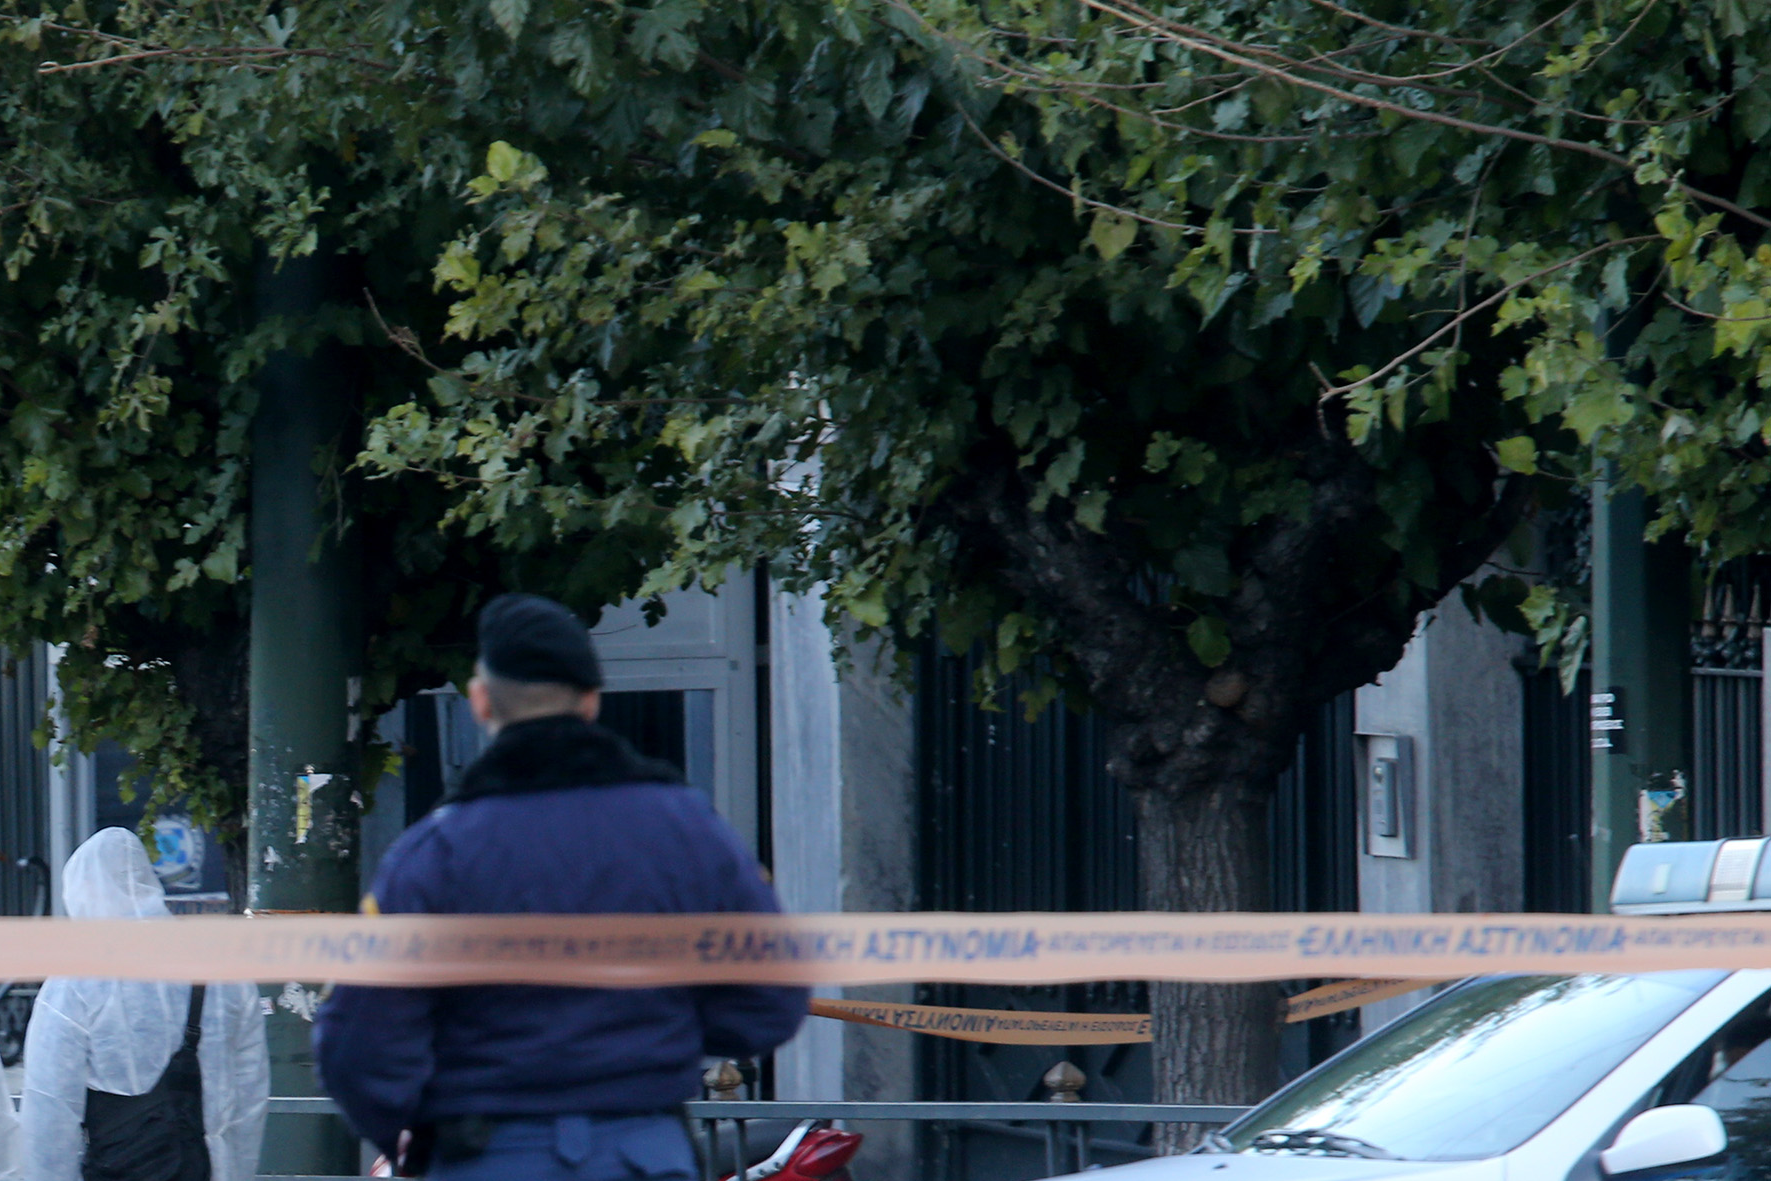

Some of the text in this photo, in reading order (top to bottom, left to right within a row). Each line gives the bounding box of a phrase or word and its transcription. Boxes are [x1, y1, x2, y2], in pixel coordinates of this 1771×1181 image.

[862, 927, 1043, 961] ΑΣΤΥΝΟΜΙΑ
[1297, 925, 1453, 957] ΕΛΛΗΝΙΚΗ
[1454, 925, 1628, 956] ΑΣΤΥΝΟΜΙΑ
